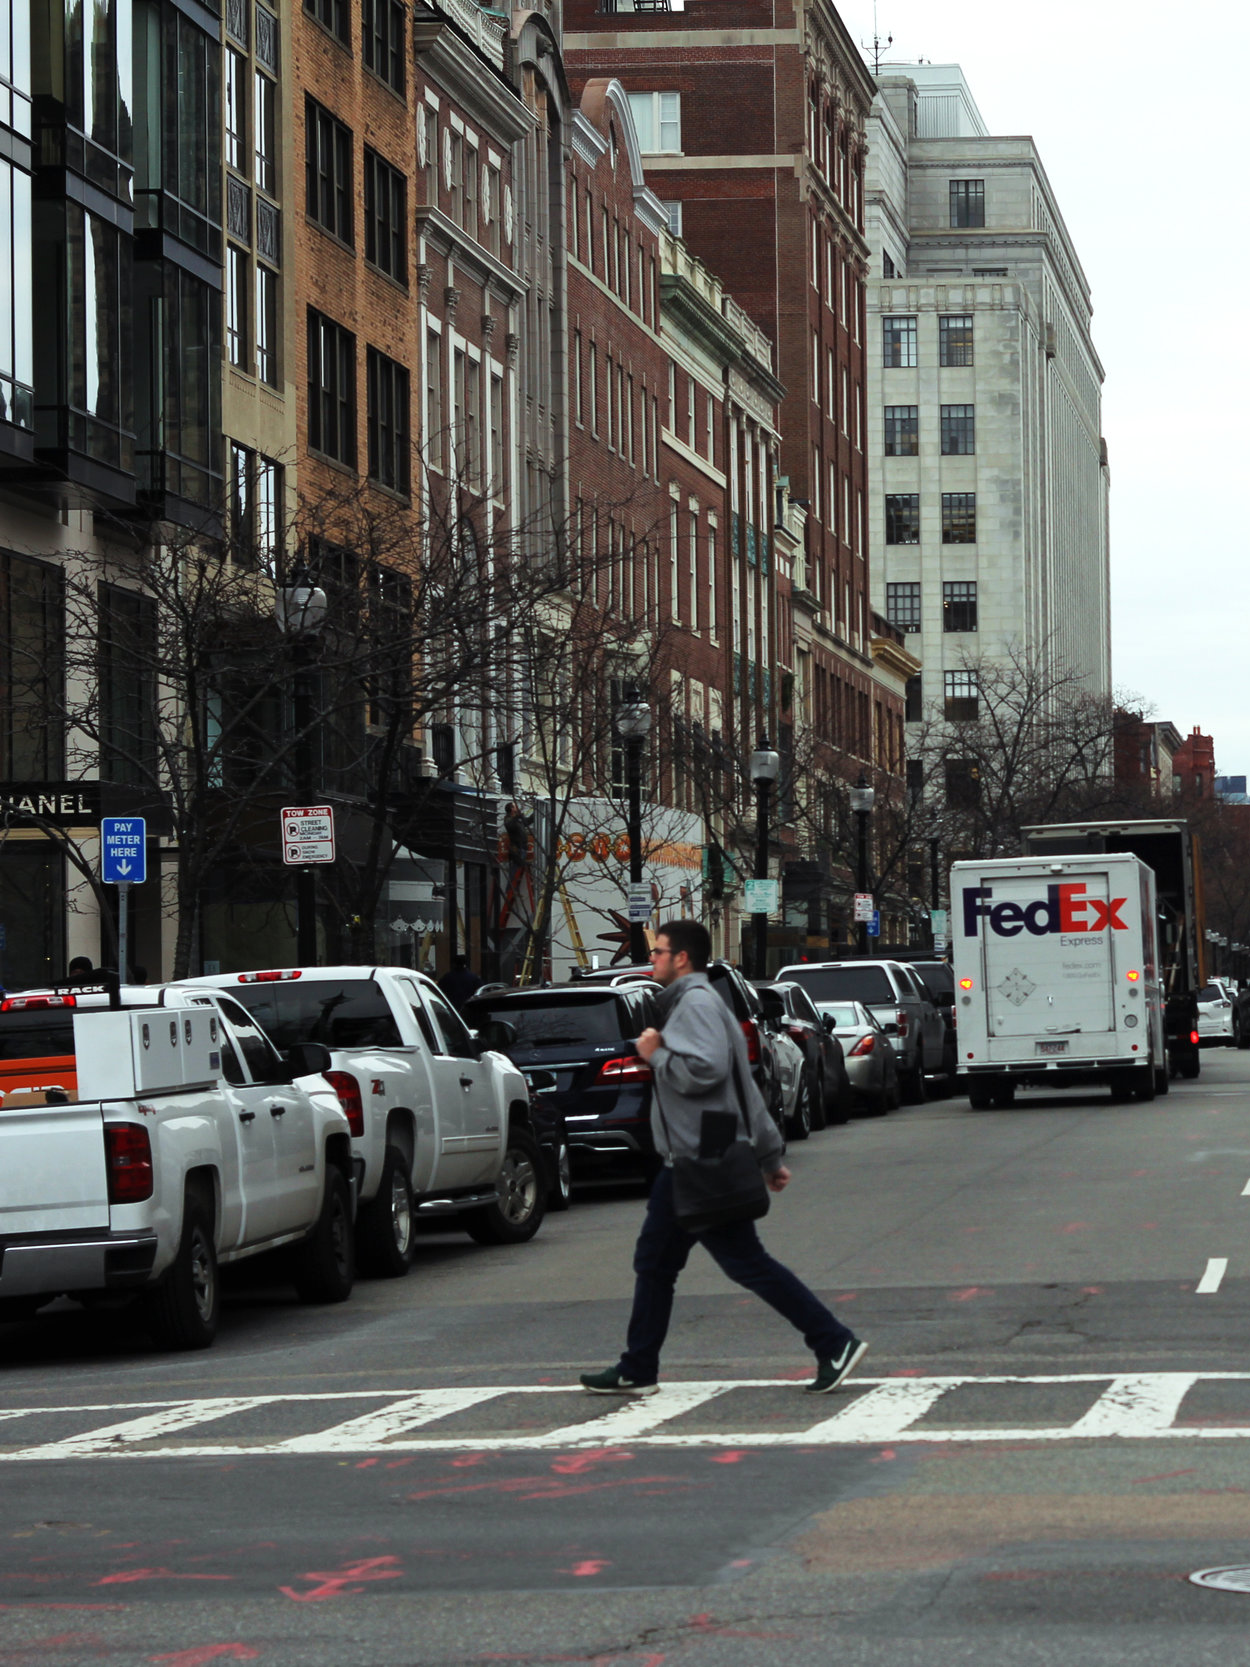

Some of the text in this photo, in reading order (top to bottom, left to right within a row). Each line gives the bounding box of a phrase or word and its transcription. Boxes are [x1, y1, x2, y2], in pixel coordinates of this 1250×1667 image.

[308, 808, 329, 816] ZONE
[114, 822, 133, 832] PAY
[106, 835, 141, 845] METER
[110, 847, 138, 857] HERE
[962, 883, 1129, 937] FedEx
[1060, 935, 1104, 948] Express
[57, 985, 105, 996] RACK
